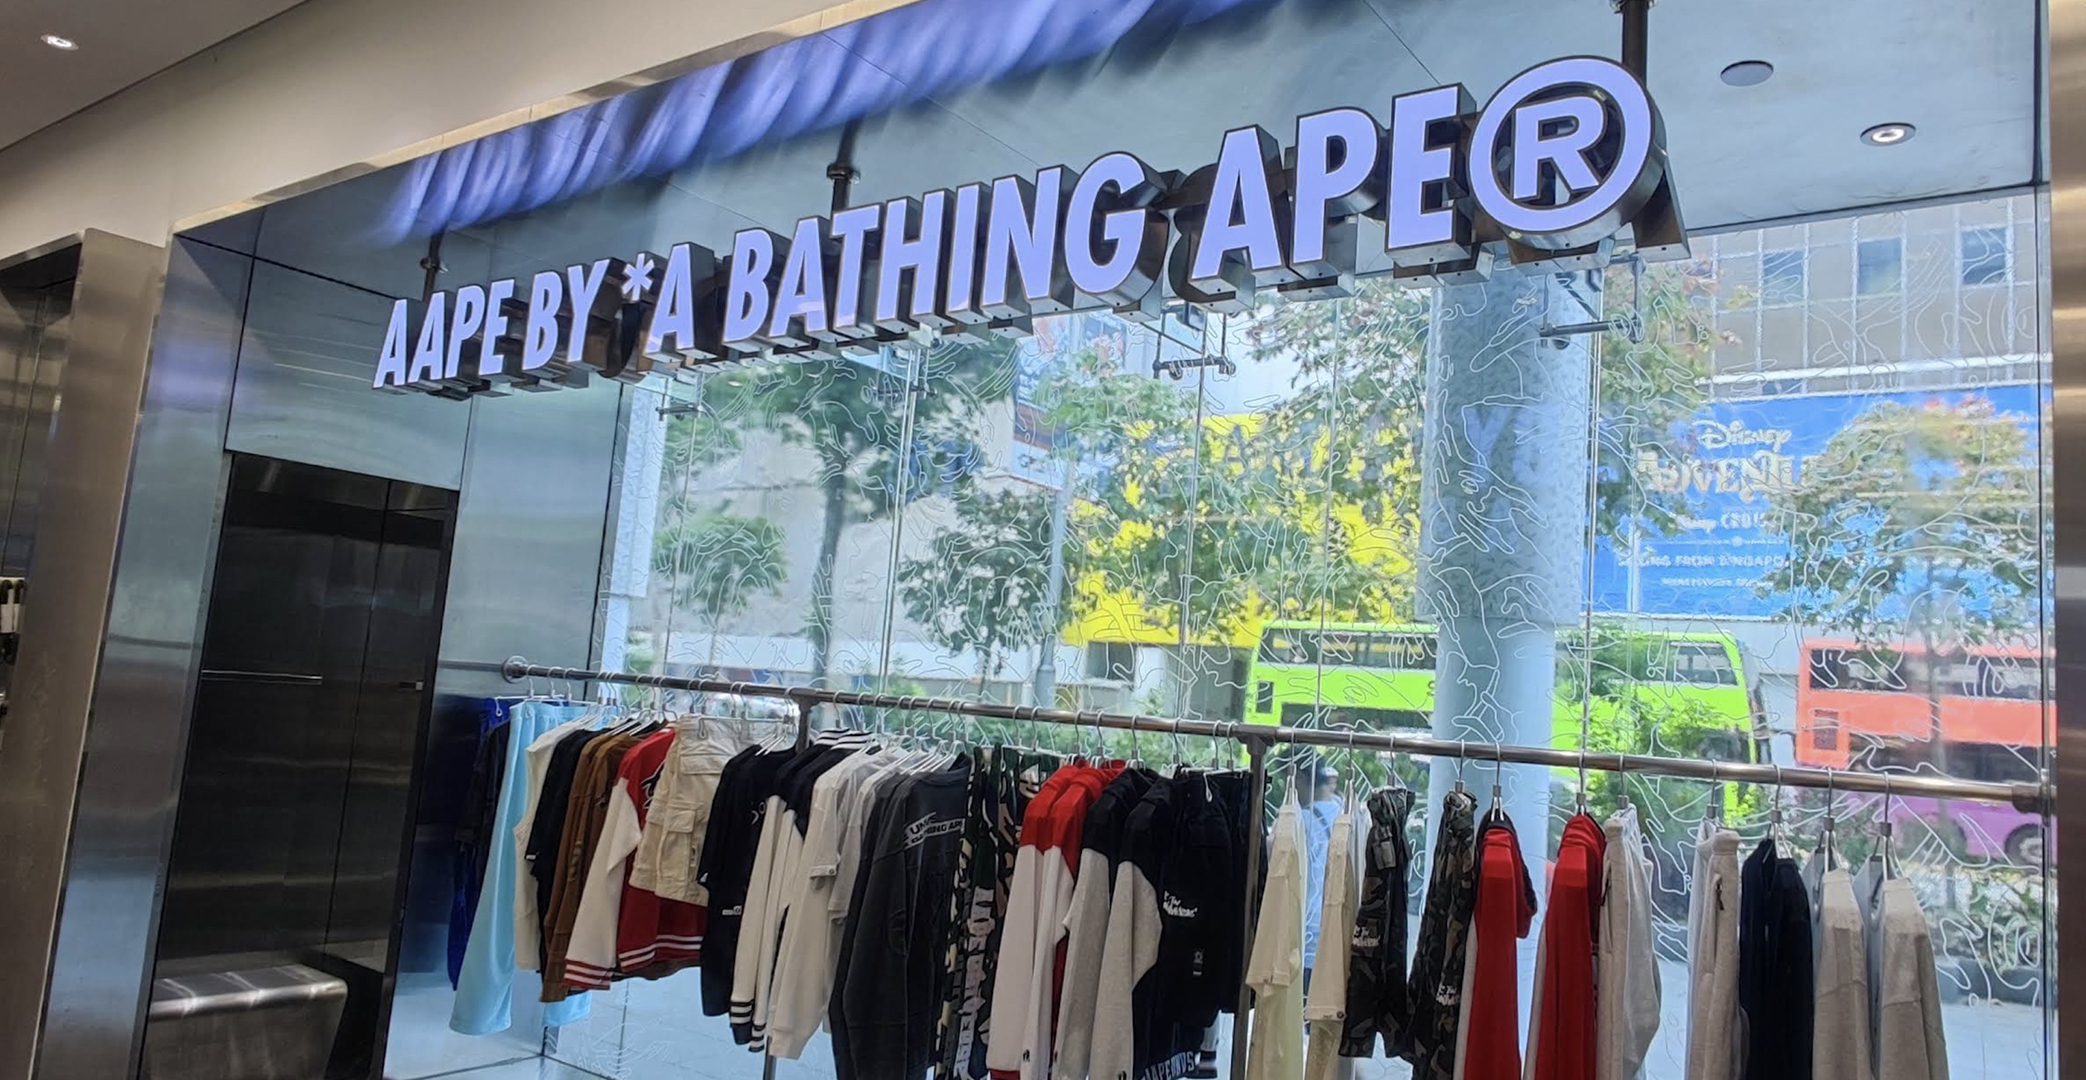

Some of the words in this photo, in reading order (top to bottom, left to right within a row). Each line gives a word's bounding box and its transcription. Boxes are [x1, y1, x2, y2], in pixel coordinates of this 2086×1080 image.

[373, 278, 515, 388] AAPE
[522, 258, 611, 372] BY
[723, 153, 1147, 343] BATHING
[1692, 419, 1793, 453] Disney
